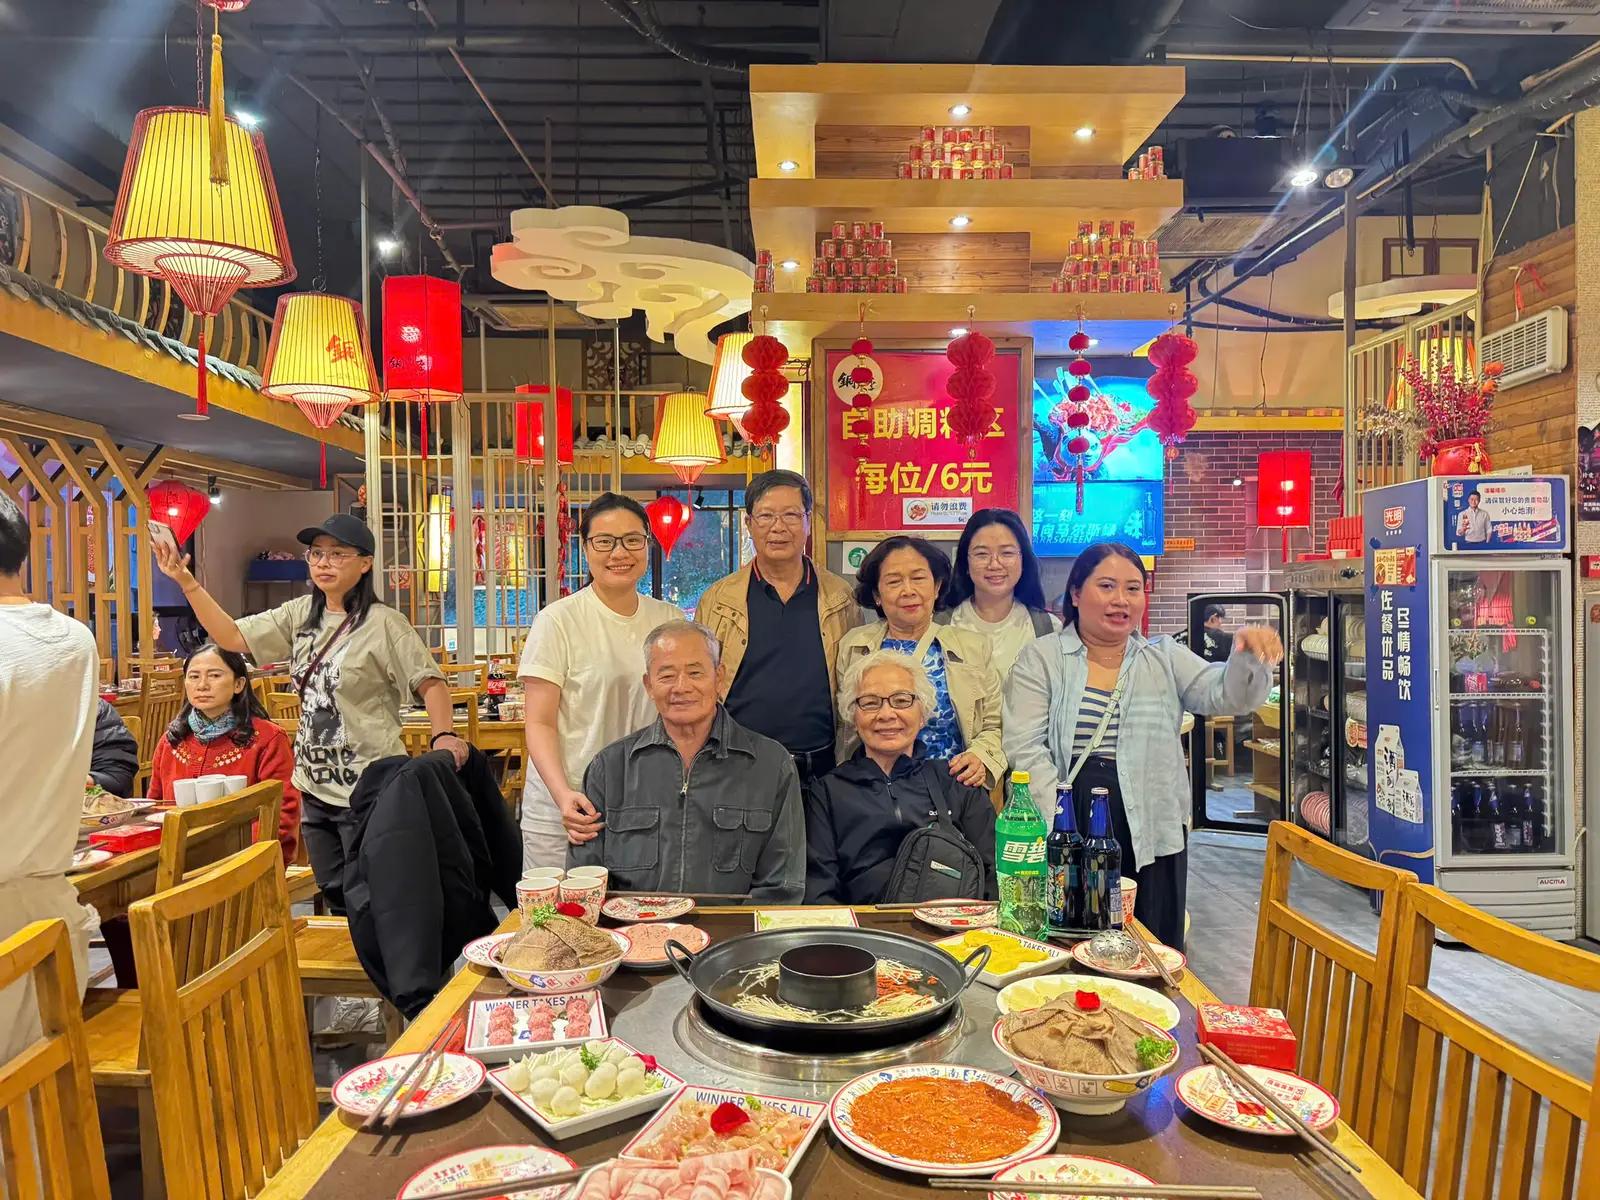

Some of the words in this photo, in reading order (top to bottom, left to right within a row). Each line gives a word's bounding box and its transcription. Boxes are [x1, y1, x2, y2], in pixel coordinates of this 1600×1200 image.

[1381, 590, 1394, 680] 佐餐优品
[1397, 607, 1411, 700] 尽情畅饮
[1001, 841, 1047, 864] 雪碧
[485, 998, 529, 1011] WNER
[532, 996, 566, 1007] TKES
[790, 1104, 813, 1118] ALL
